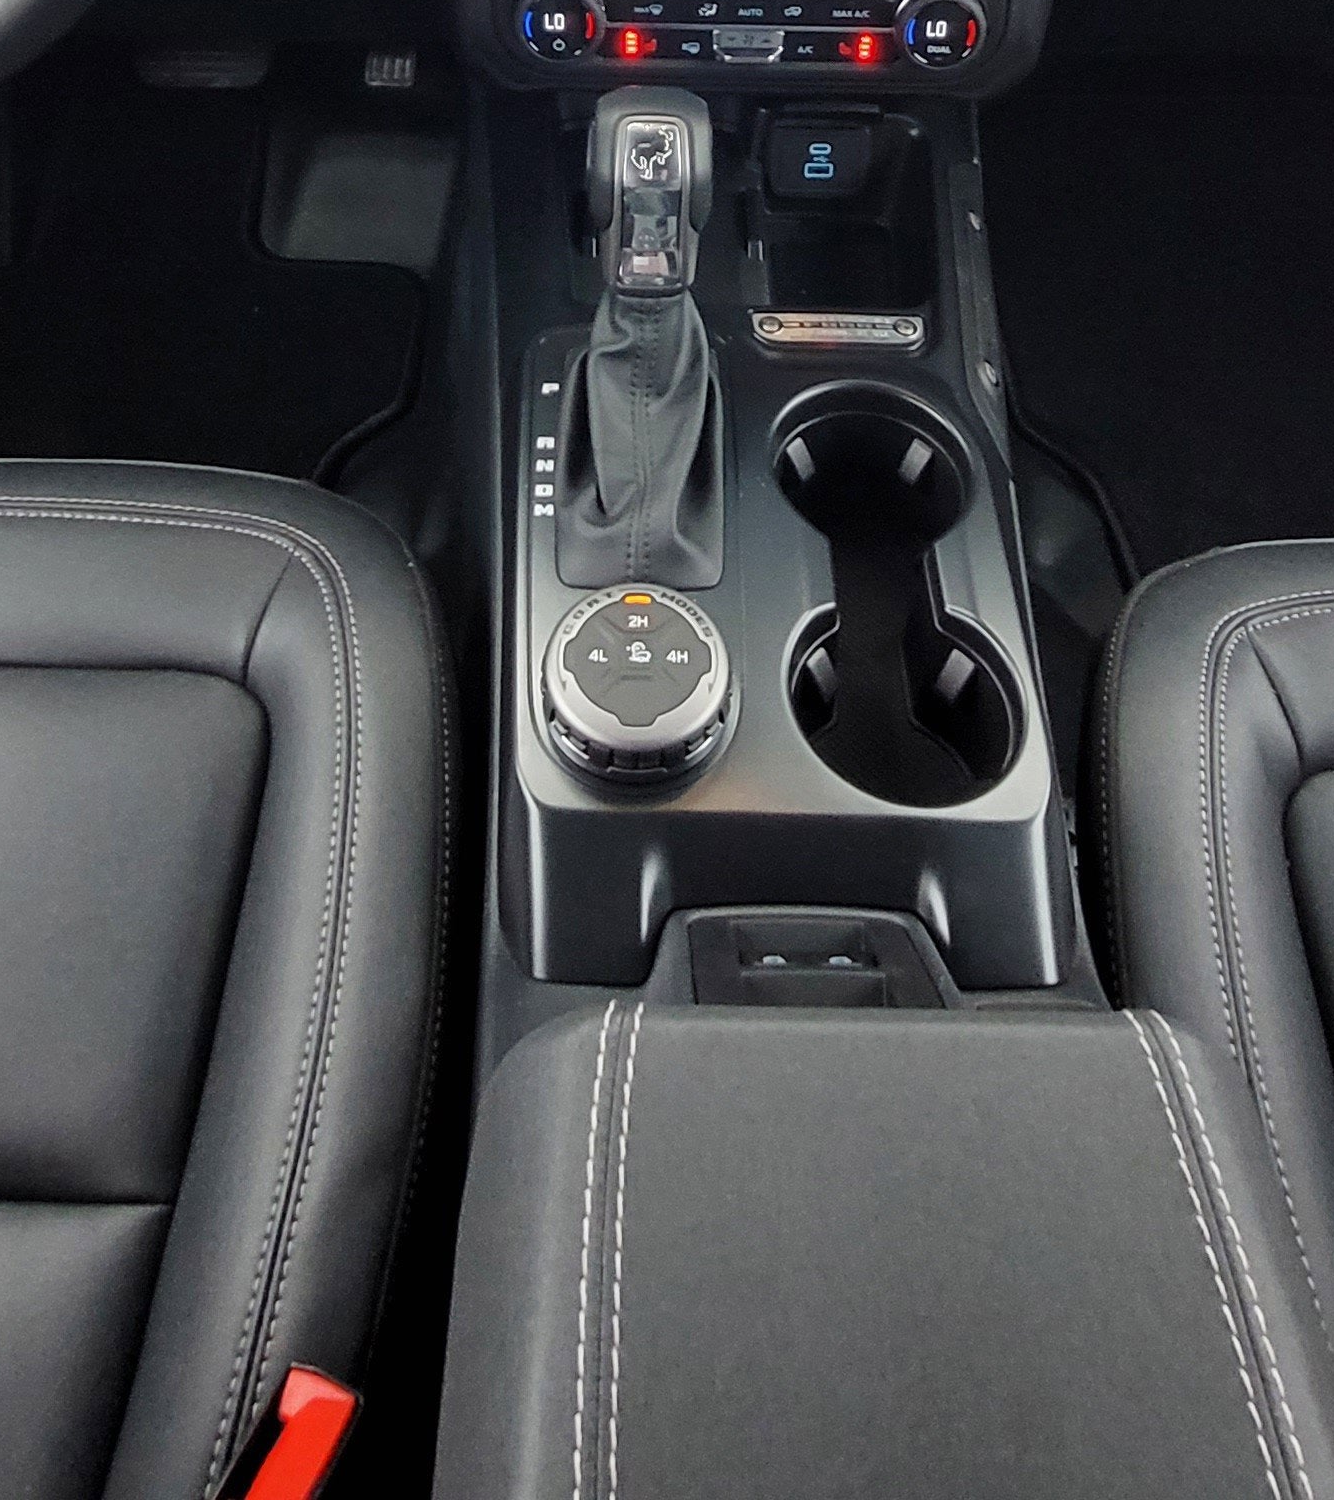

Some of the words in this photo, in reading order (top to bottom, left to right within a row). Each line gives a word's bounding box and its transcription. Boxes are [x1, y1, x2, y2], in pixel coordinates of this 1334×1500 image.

[738, 7, 764, 17] AUTO
[544, 12, 565, 31] LO
[925, 19, 948, 38] LO
[535, 459, 555, 472] N
[533, 503, 555, 516] M
[627, 615, 650, 628] 2H
[660, 591, 714, 638] MODES
[588, 648, 609, 663] 4L
[666, 650, 689, 664] 4H
